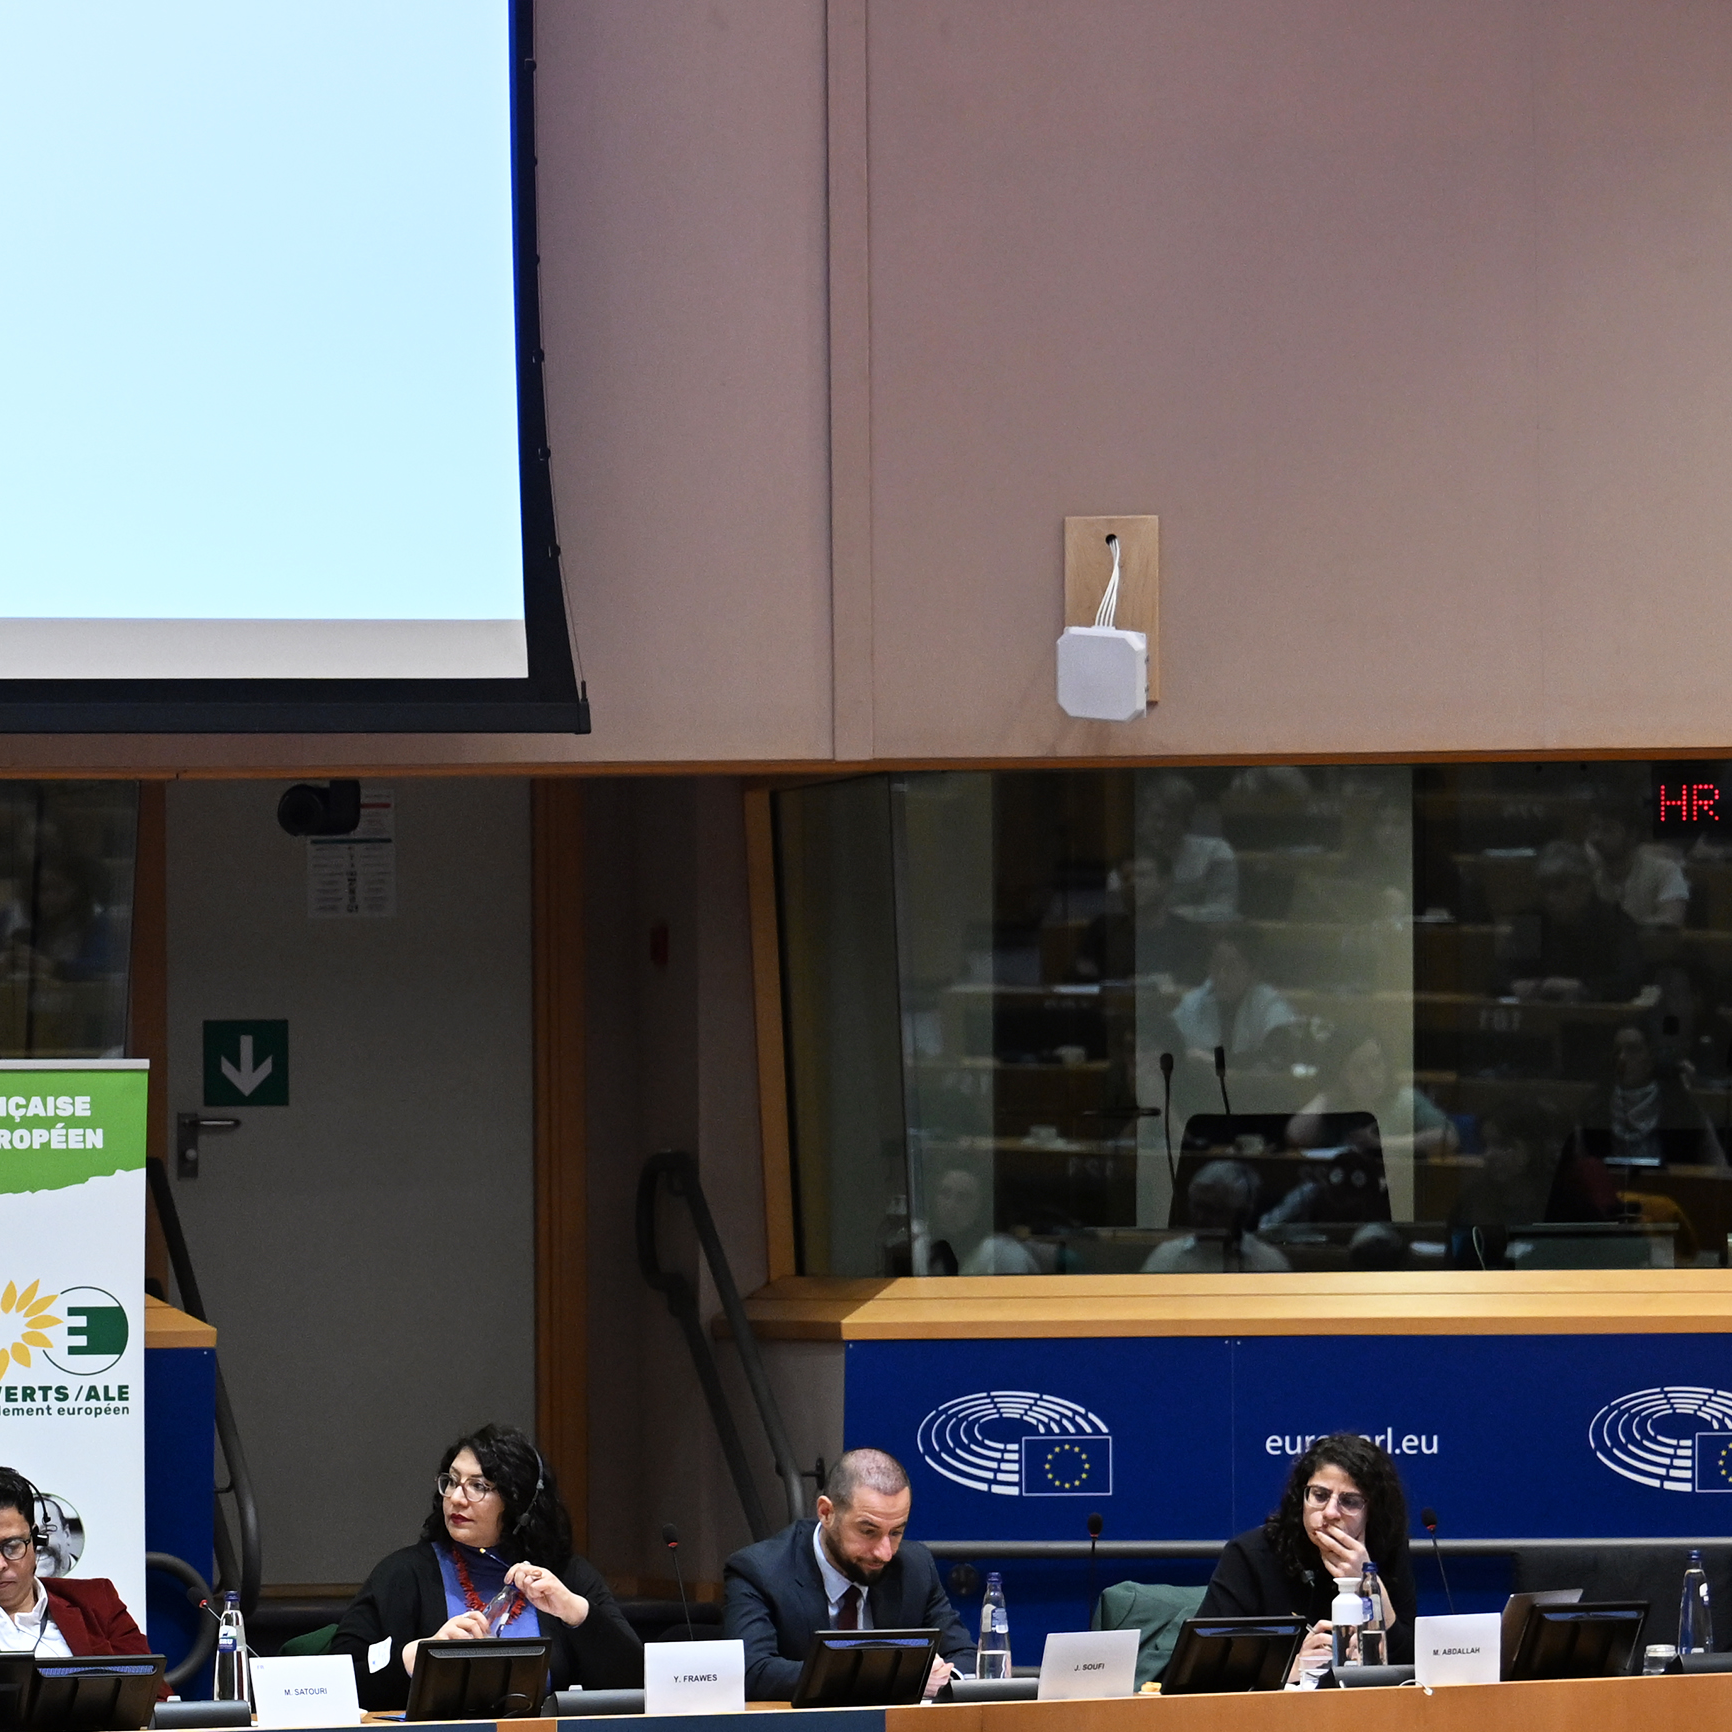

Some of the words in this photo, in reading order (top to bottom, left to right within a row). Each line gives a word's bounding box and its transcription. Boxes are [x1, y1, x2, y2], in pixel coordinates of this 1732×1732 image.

[1660, 783, 1721, 822] HR
[57, 1404, 130, 1420] européen
[1442, 1647, 1481, 1655] ABDALLAH
[683, 1674, 717, 1682] FRAWES
